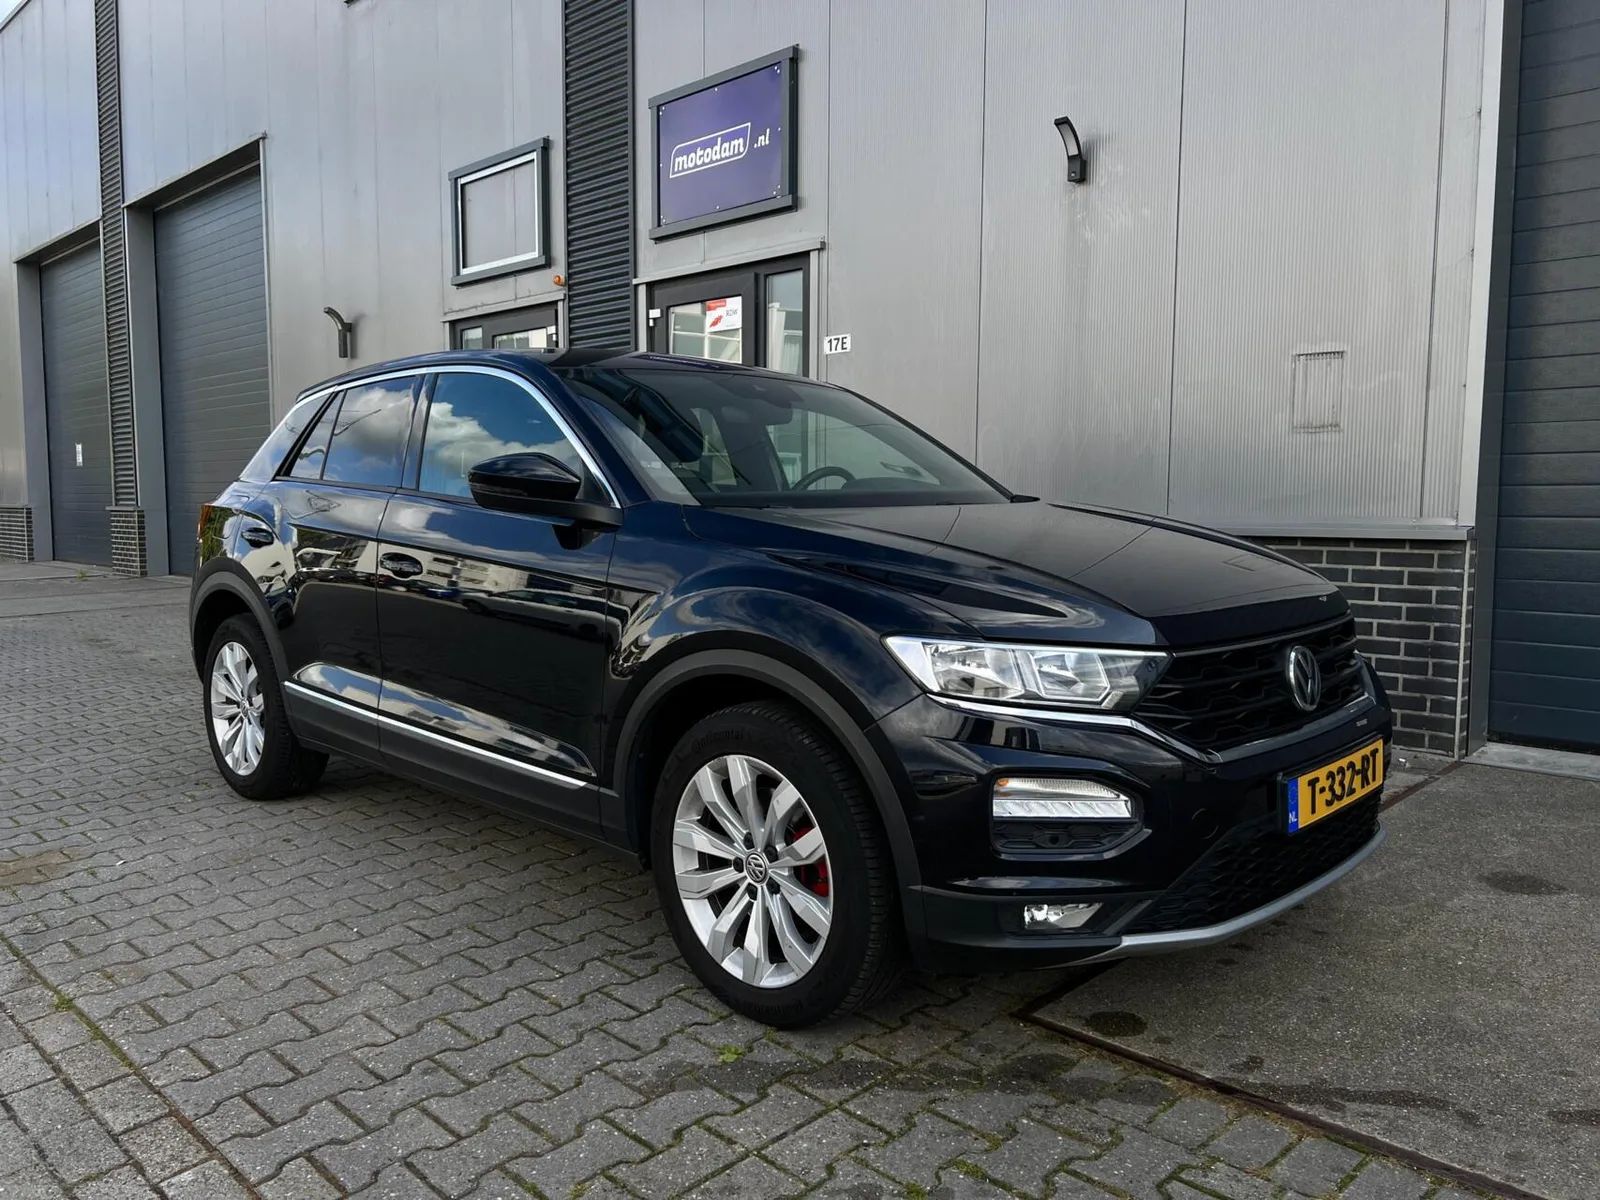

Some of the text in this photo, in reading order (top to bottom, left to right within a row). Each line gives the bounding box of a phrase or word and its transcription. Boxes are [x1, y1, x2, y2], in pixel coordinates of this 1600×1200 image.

[674, 128, 770, 172] motodam .nl
[827, 336, 848, 352] 17E
[1307, 747, 1379, 815] T-332-RT
[1288, 811, 1298, 824] NL
